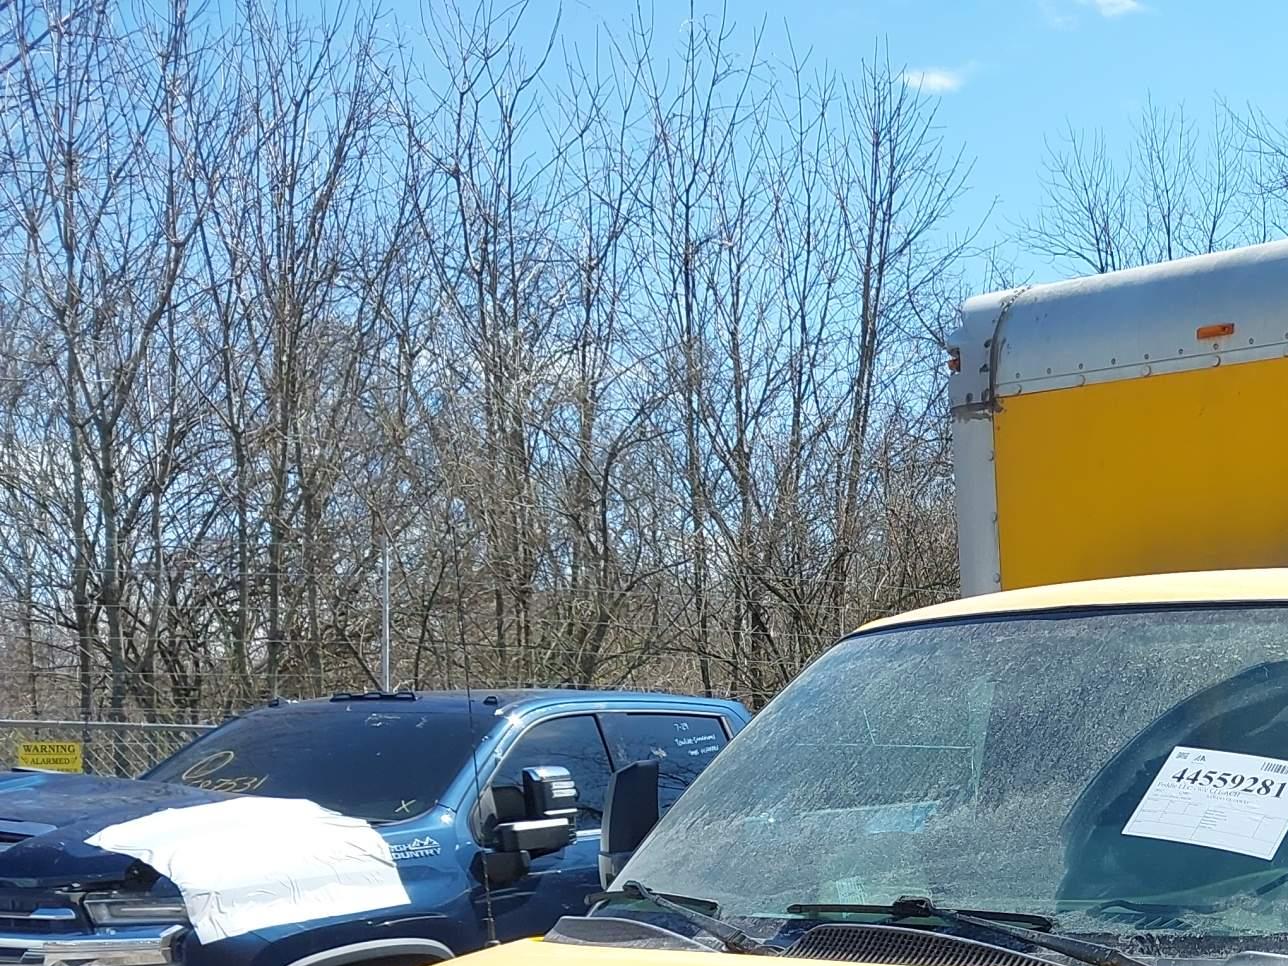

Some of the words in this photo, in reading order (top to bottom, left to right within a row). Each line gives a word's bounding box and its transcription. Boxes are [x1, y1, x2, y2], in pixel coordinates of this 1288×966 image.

[23, 745, 76, 753] WARNING
[31, 757, 70, 765] ALARMED
[1171, 767, 1288, 799] 44559281
